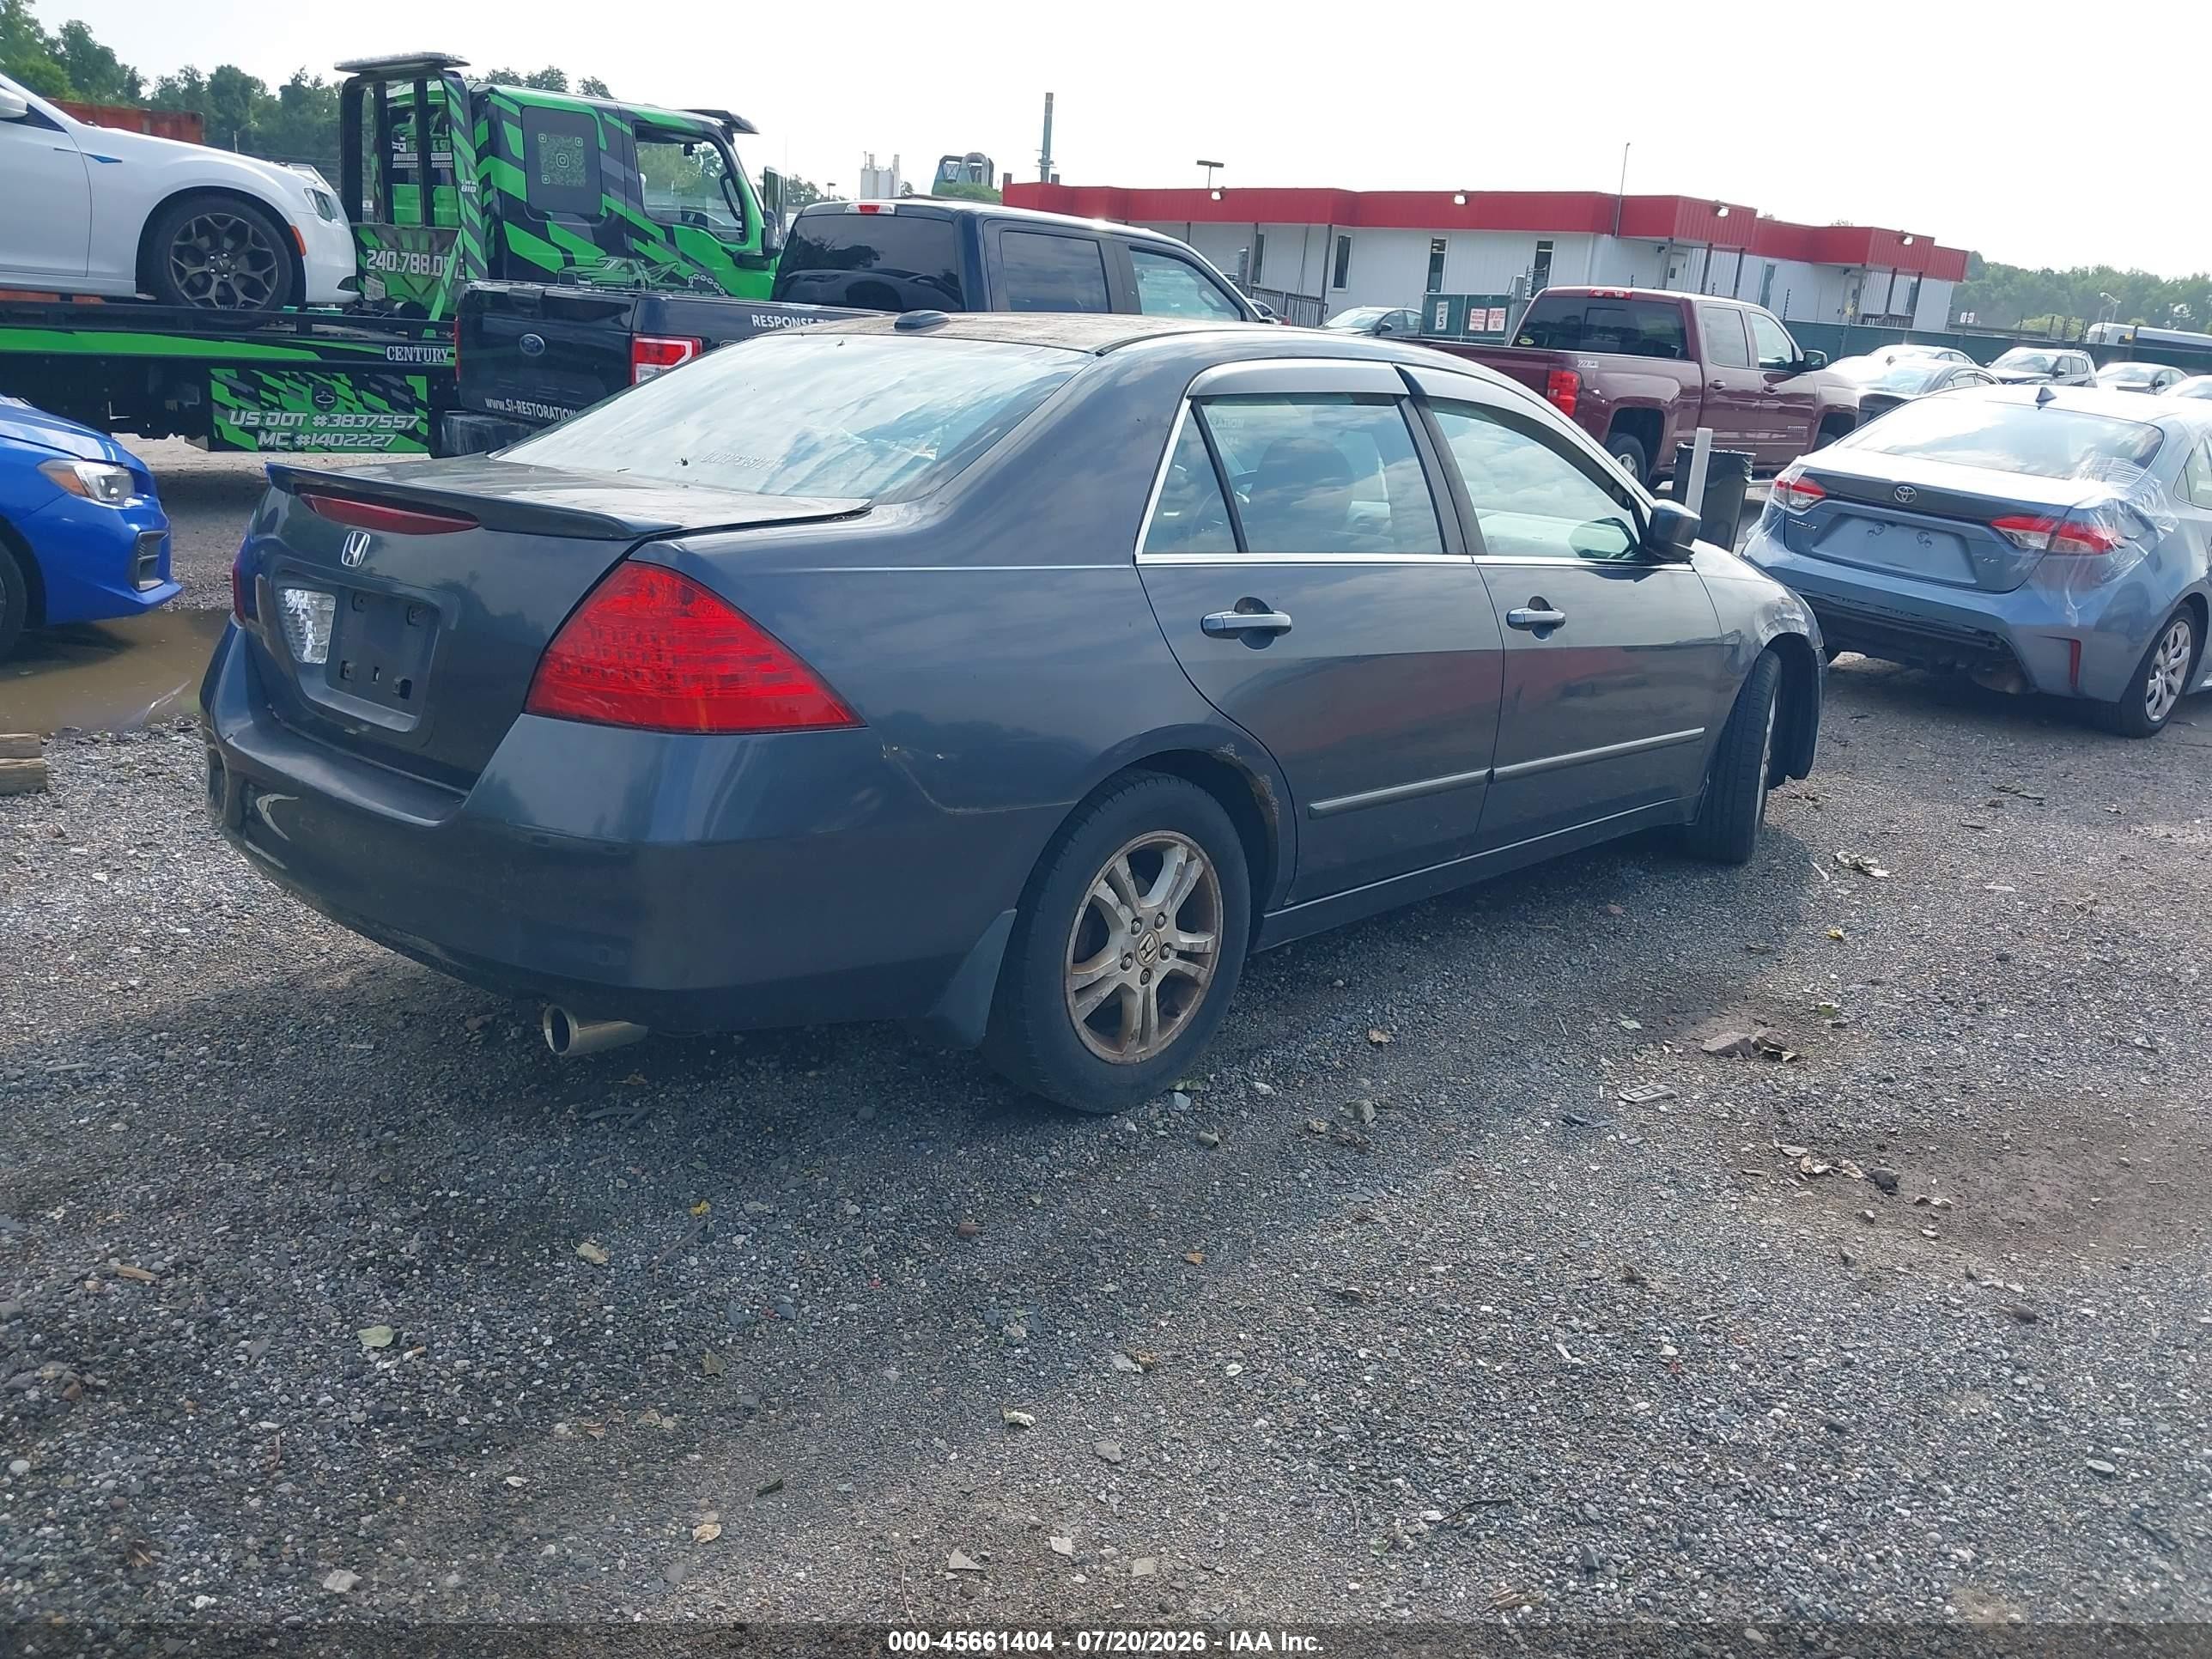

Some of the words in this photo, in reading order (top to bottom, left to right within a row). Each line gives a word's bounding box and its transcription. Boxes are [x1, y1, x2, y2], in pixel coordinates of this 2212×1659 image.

[1438, 316, 1444, 327] 5
[386, 345, 449, 363] CENTURY
[229, 410, 260, 426] US
[265, 412, 307, 427] DOT
[312, 413, 420, 428] #3837557
[258, 431, 291, 446] MC
[295, 433, 396, 447] #1402227
